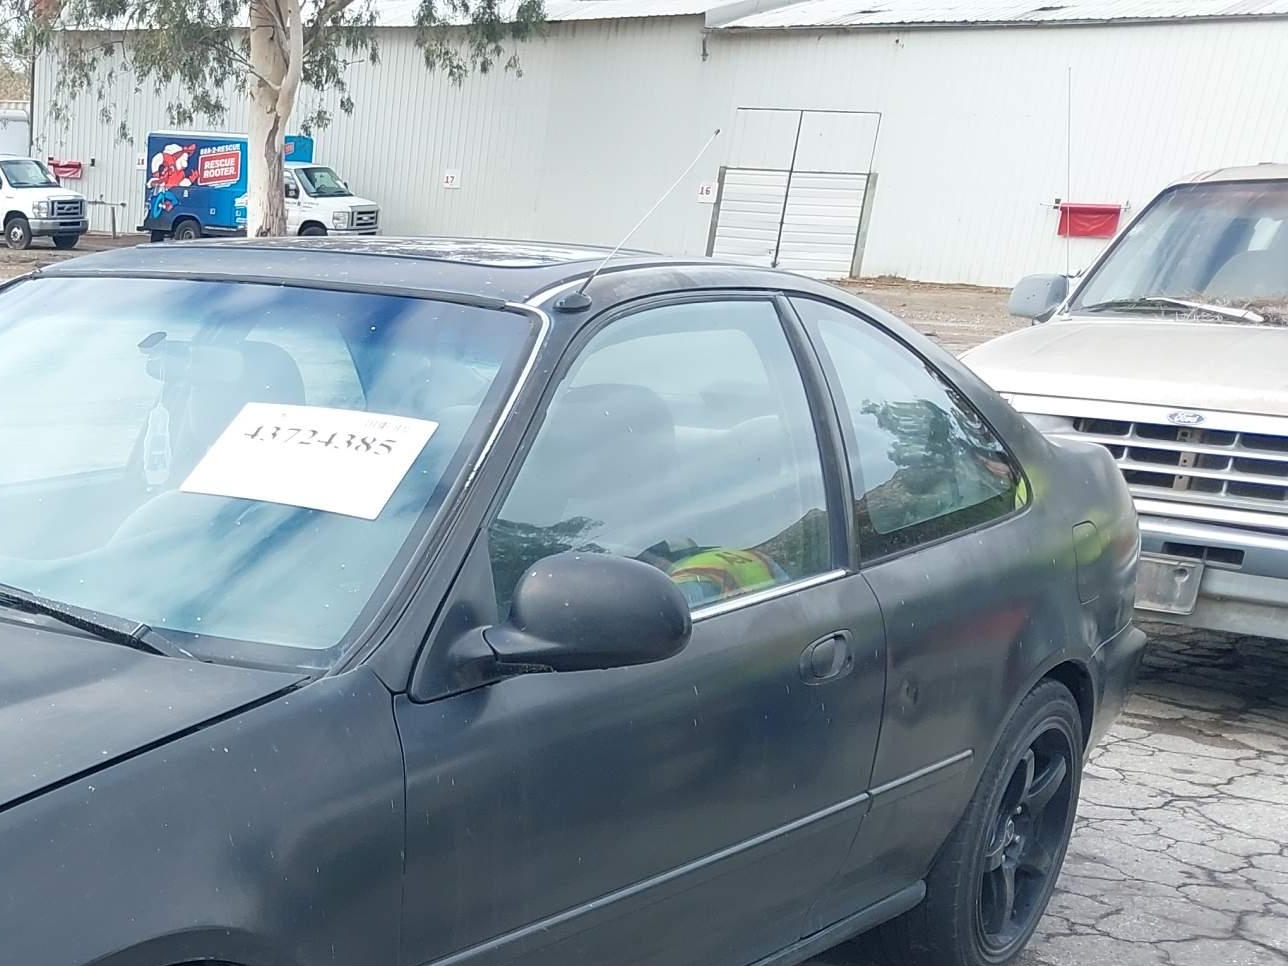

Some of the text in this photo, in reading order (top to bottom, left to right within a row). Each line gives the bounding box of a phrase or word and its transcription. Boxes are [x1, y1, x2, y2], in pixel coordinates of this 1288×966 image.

[204, 157, 236, 170] RESCUE
[444, 175, 455, 185] 17
[698, 186, 711, 195] 16
[244, 425, 398, 455] 43724385
